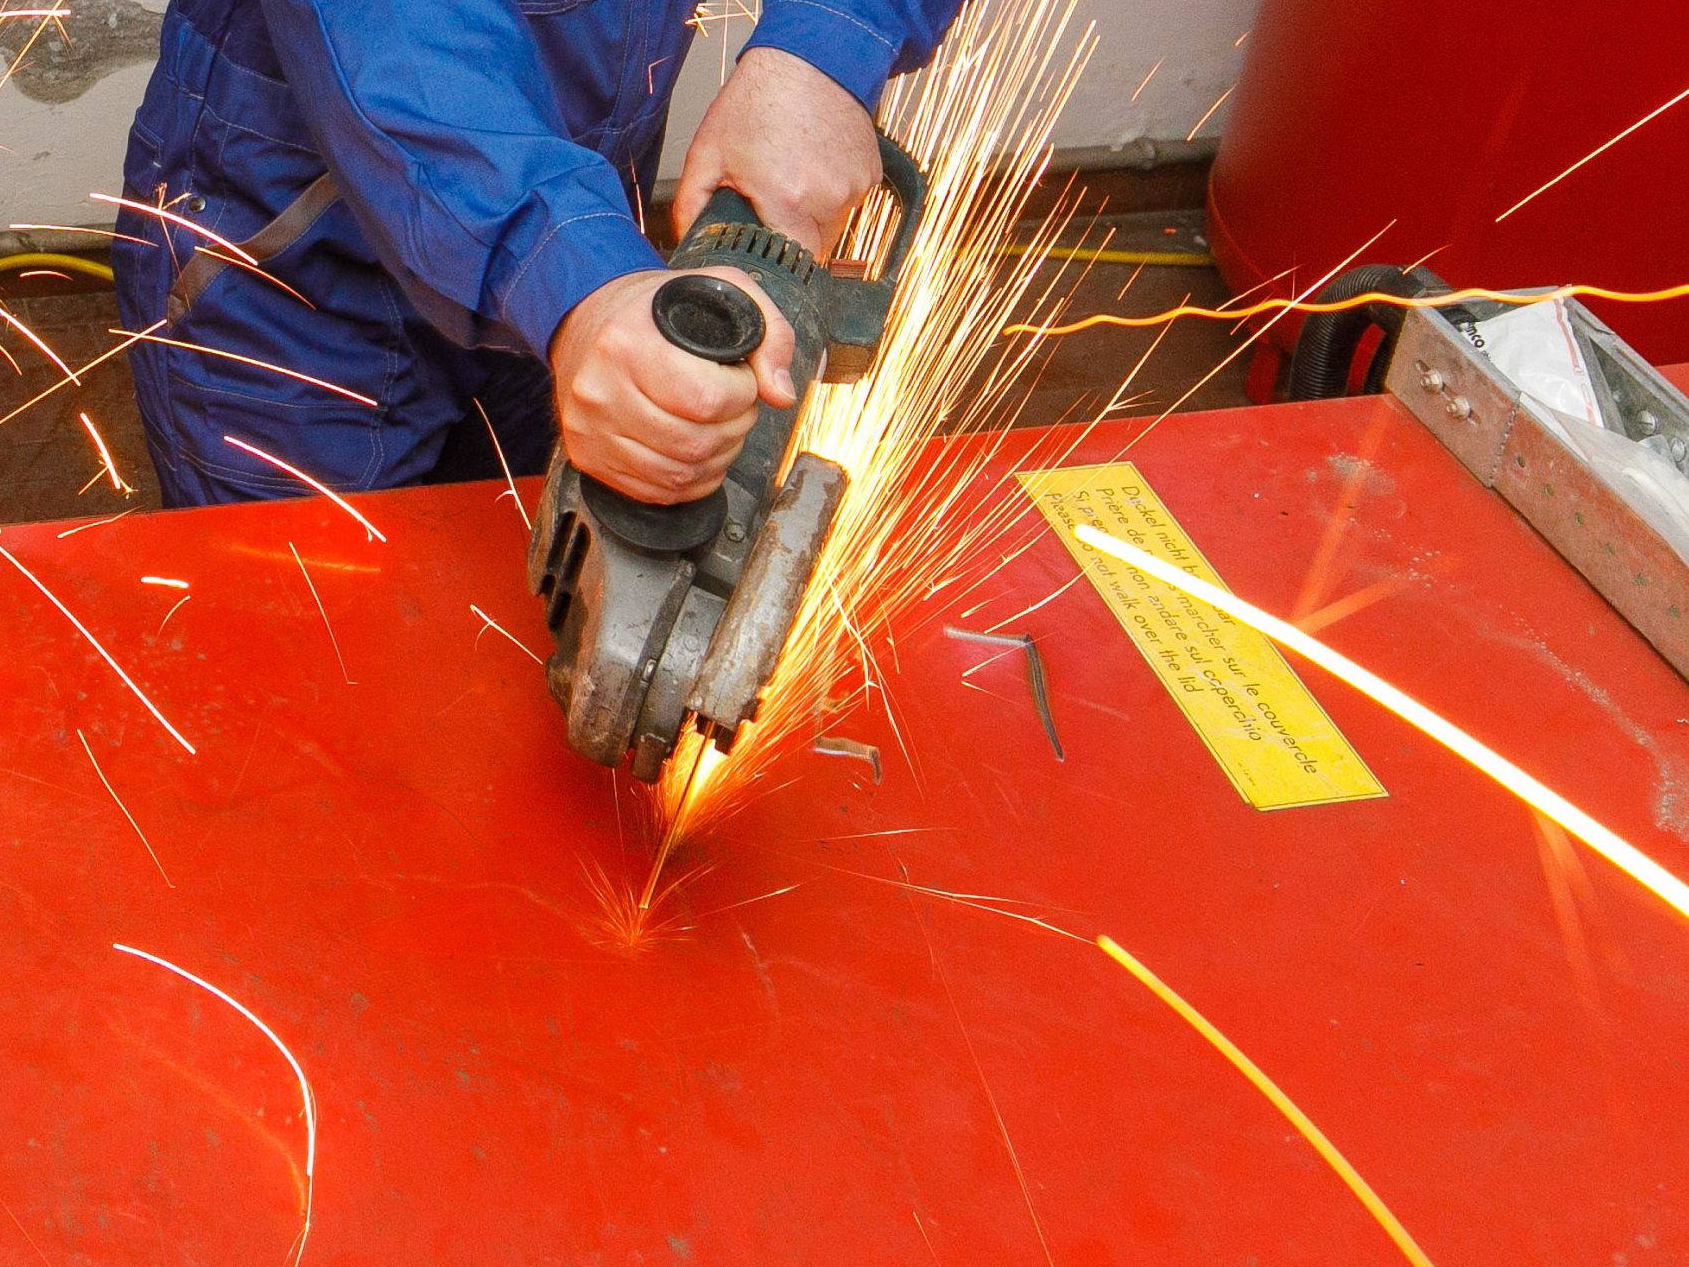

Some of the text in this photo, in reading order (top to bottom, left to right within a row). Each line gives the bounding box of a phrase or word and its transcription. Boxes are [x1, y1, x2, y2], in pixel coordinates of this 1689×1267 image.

[1156, 532, 1190, 561] nicht
[1090, 557, 1117, 576] not
[1110, 580, 1141, 610] walk
[1133, 614, 1163, 648] over
[1159, 648, 1182, 673] the
[1176, 675, 1206, 695] lid
[1096, 487, 1129, 524] Prière
[1126, 529, 1146, 545] de
[1176, 595, 1227, 651] marcher
[1223, 656, 1247, 678] sur
[1242, 681, 1261, 697] le
[1256, 700, 1318, 775] couvercle
[1126, 566, 1151, 591] non
[1148, 595, 1188, 641] andare
[1186, 645, 1207, 668] sul
